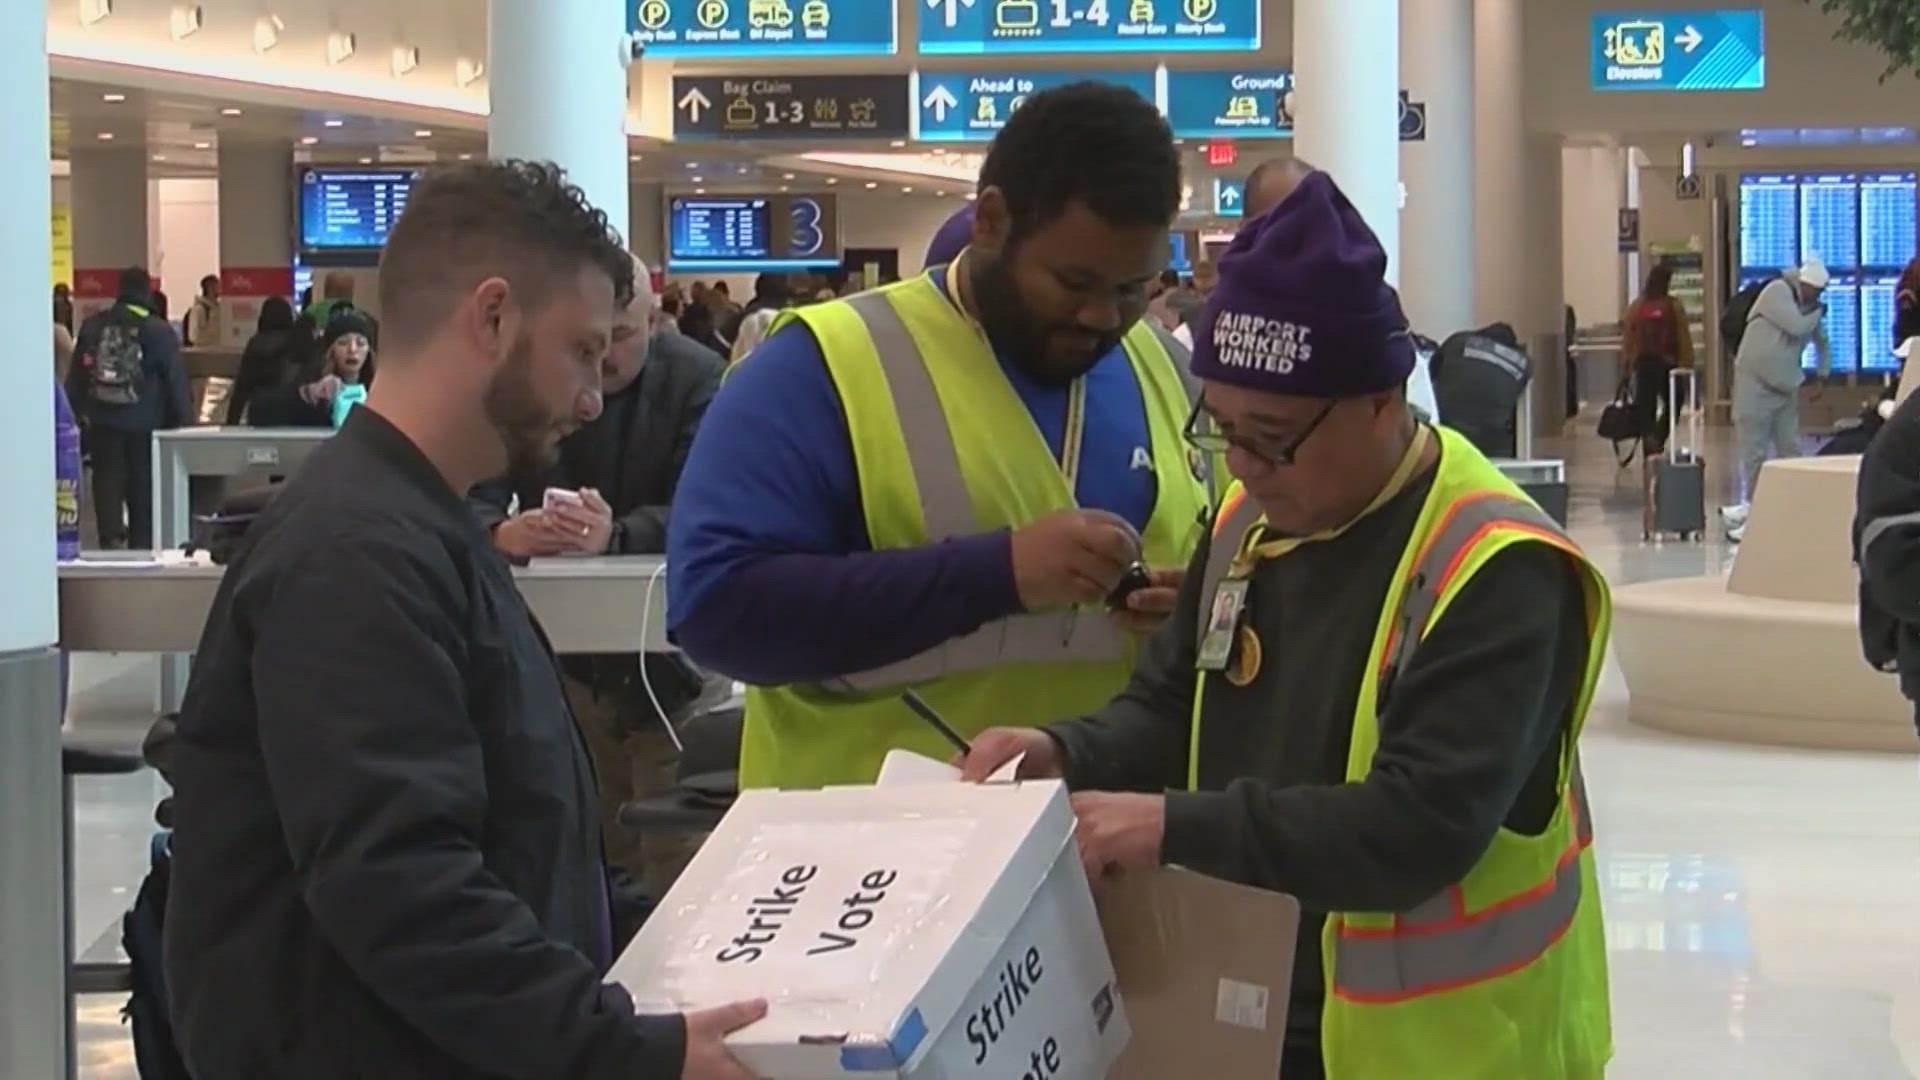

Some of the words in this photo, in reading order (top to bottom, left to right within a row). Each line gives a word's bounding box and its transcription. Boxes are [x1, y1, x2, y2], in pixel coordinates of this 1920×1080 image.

[1050, 0, 1109, 27] 1-4
[723, 80, 748, 97] Bag
[752, 80, 792, 95] Claim
[969, 77, 1014, 93] Ahead
[1017, 79, 1034, 93] to
[1231, 75, 1284, 90] Ground
[764, 101, 804, 123] 1-3
[791, 198, 823, 256] 3
[1213, 327, 1312, 361] WORKERS
[1219, 346, 1294, 374] UNITED
[716, 865, 817, 963] Strike
[806, 869, 897, 956] Vote
[966, 945, 1043, 1066] Strike
